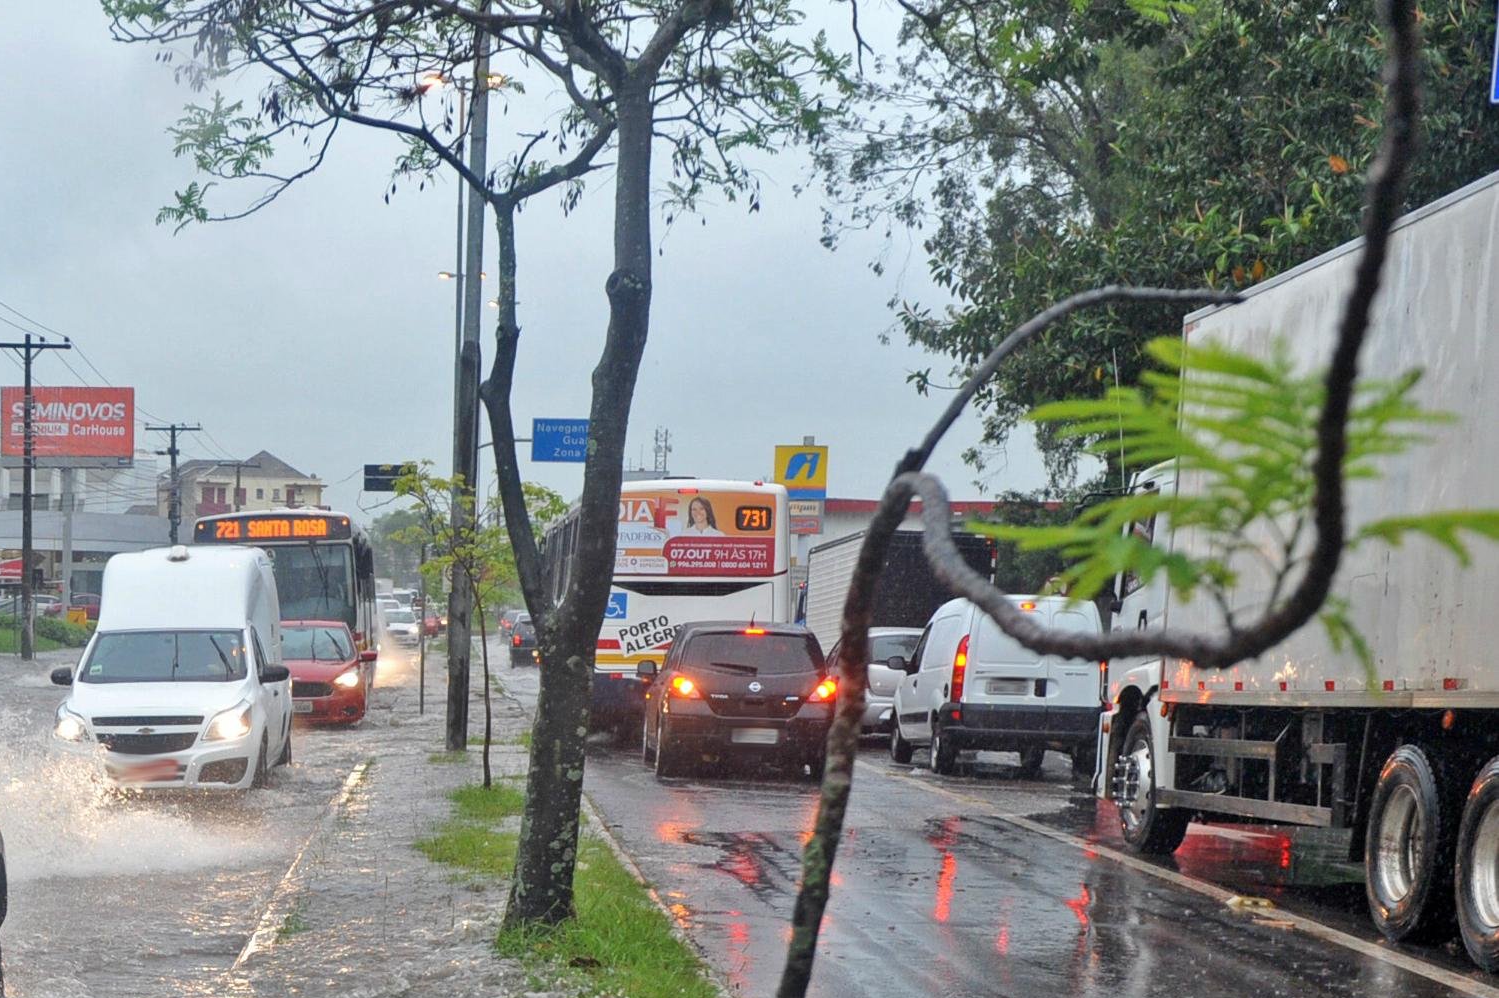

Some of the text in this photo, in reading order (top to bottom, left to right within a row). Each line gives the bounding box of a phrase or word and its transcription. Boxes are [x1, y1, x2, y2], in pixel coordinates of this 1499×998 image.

[72, 424, 126, 436] CarHouse
[553, 448, 581, 457] Zona
[741, 510, 767, 527] 731
[216, 519, 327, 538] 721 SANTA ROSA
[620, 532, 662, 541] FADERGS
[670, 547, 767, 560] 07.OUT 9H ÀS 17H
[618, 615, 669, 641] PORTO
